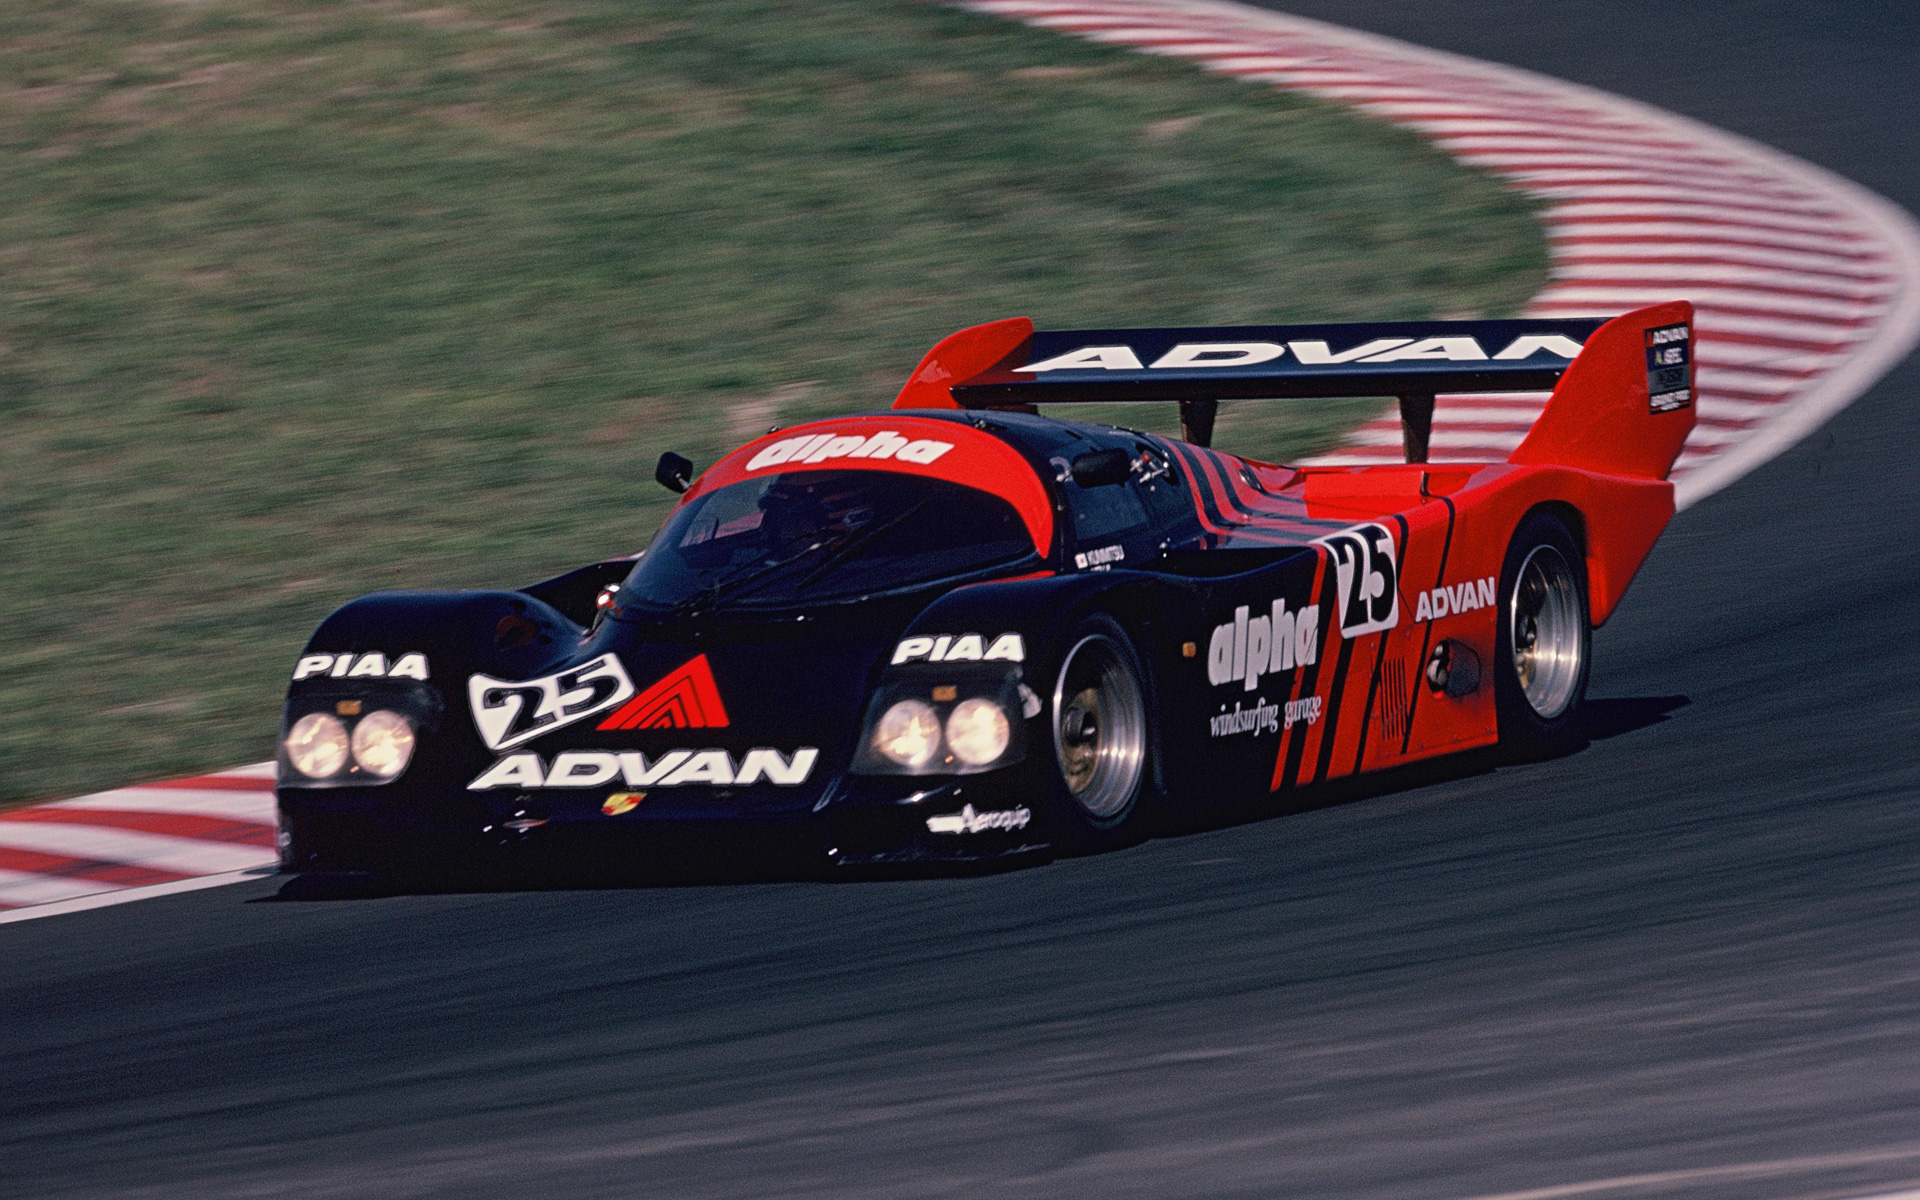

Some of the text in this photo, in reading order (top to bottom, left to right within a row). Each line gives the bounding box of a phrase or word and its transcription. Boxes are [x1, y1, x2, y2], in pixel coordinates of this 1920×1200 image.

[1012, 333, 1585, 373] ADVAN
[745, 431, 954, 471] alpha
[1323, 525, 1395, 630] 25
[1415, 576, 1496, 623] ADVAN
[891, 634, 1024, 665] PIAA
[1207, 597, 1320, 692] alpha
[293, 652, 427, 681] PIAA
[483, 658, 620, 745] 25
[1210, 695, 1323, 738] windsurfing garage
[467, 748, 819, 790] ADVAN
